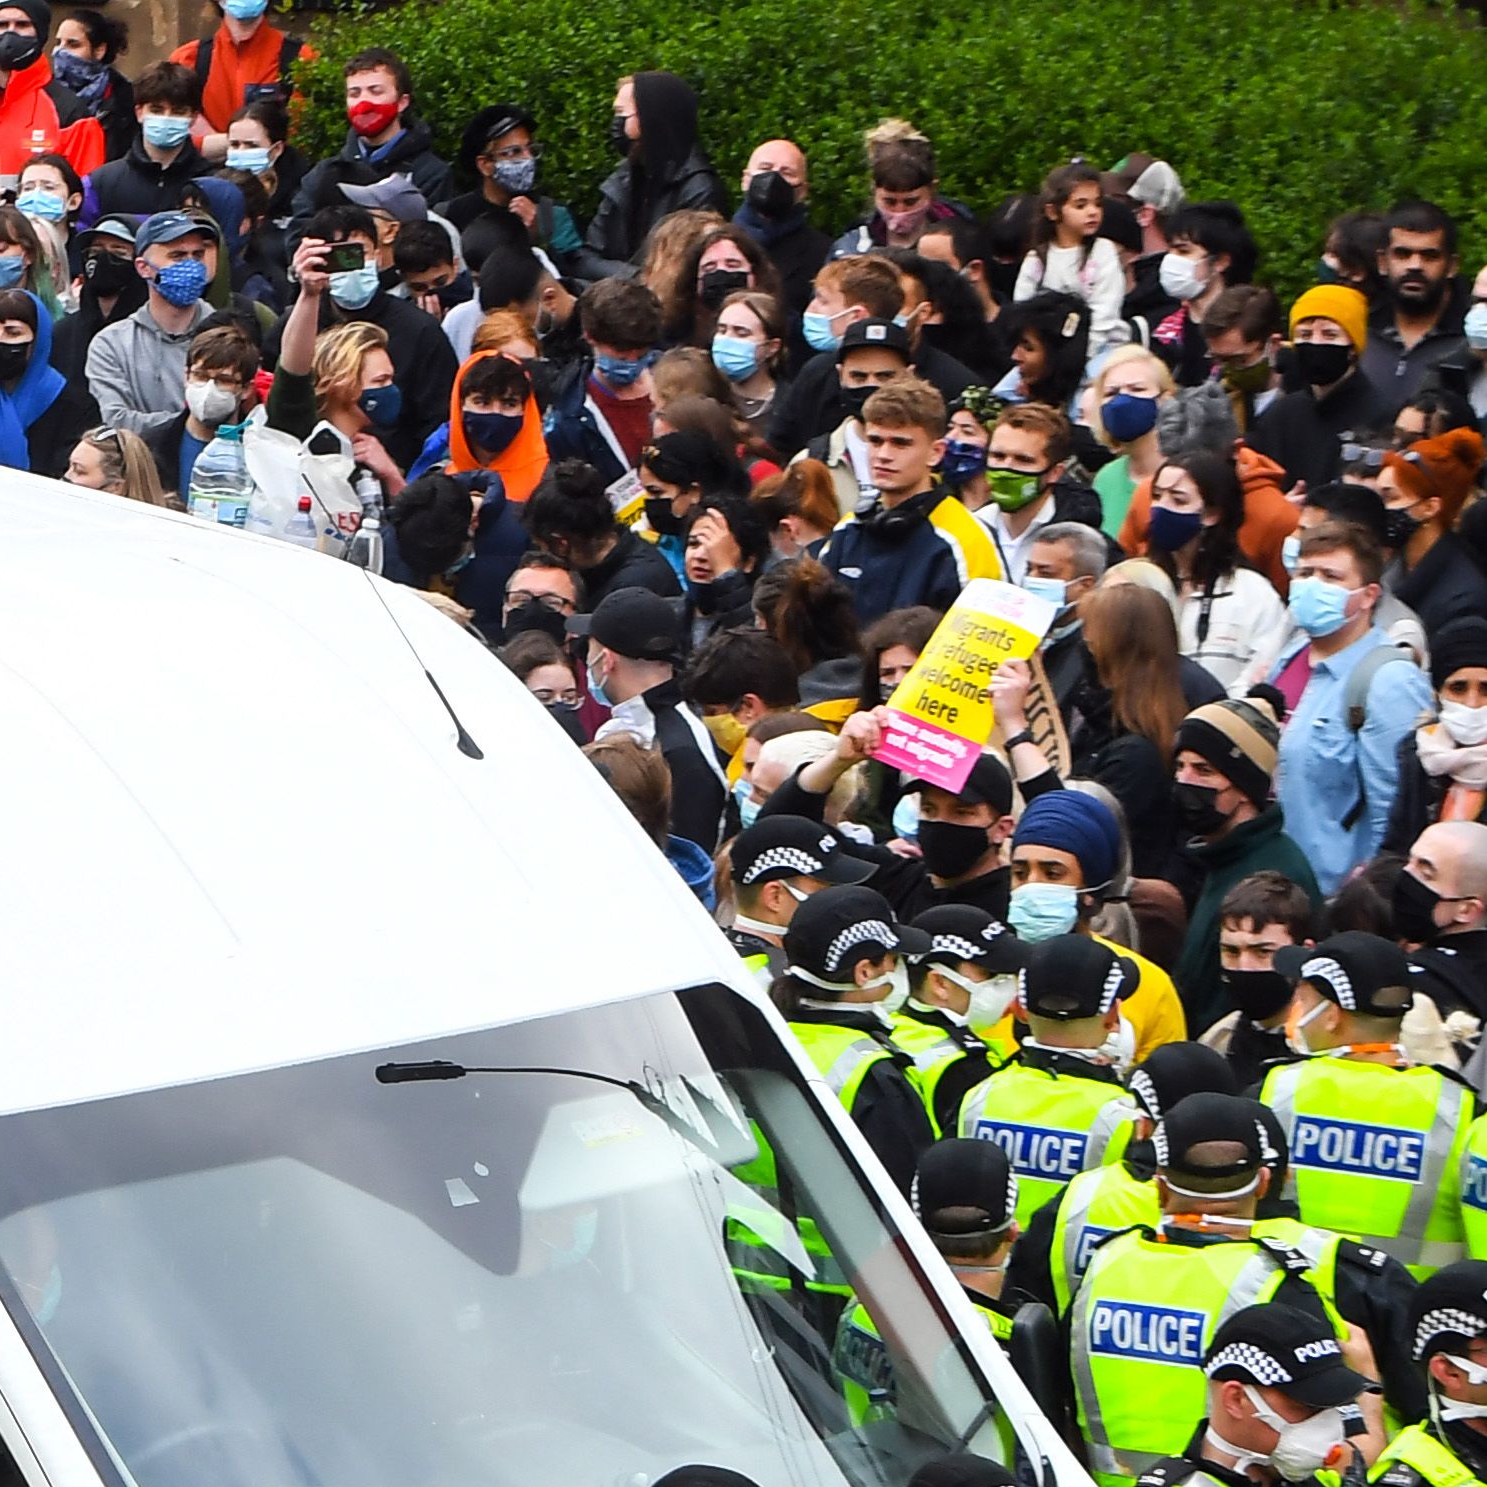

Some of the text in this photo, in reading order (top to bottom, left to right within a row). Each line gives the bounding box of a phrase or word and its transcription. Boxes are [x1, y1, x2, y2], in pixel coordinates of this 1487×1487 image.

[950, 612, 1017, 652] Migrants
[941, 640, 1001, 675] refugee
[919, 667, 992, 705] welcome
[915, 689, 960, 725] here
[978, 1126, 1084, 1176] POLICE
[1292, 1124, 1424, 1176] POLICE
[1093, 1305, 1202, 1361] POLICE
